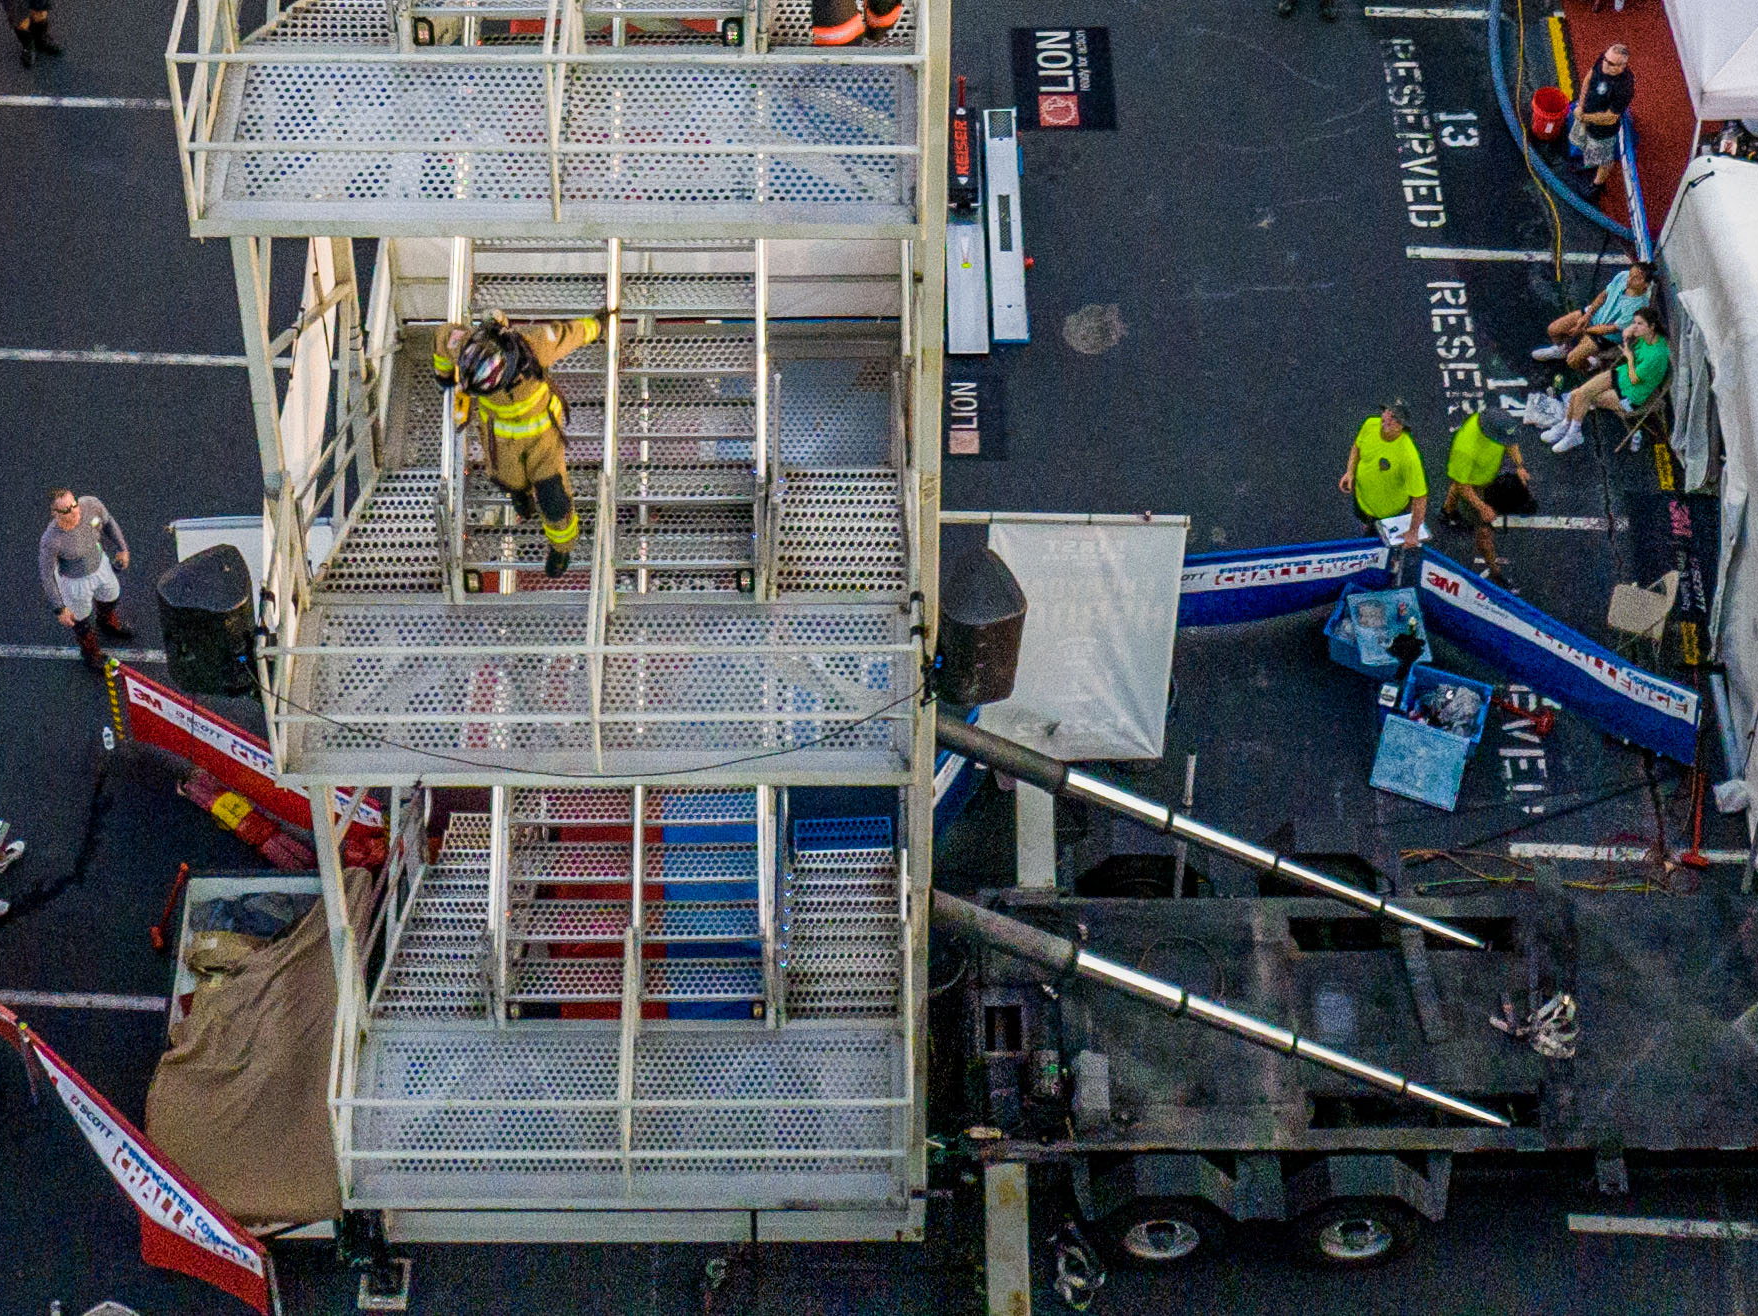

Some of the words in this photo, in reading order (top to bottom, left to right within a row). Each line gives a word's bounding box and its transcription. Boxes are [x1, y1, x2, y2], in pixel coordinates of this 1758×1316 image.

[1036, 29, 1069, 95] LION
[954, 118, 970, 177] KEISER
[1381, 37, 1447, 231] RESERVED
[1433, 109, 1481, 149] 13
[949, 381, 978, 431] LION
[1180, 572, 1206, 582] OTT
[1426, 571, 1461, 598] 3M
[132, 687, 164, 712] 3M
[186, 715, 224, 740] SCOTT
[78, 1102, 114, 1139] SCOTT
[121, 1139, 194, 1217] FIREFIGHTER
[193, 1214, 251, 1261] COMBAT
